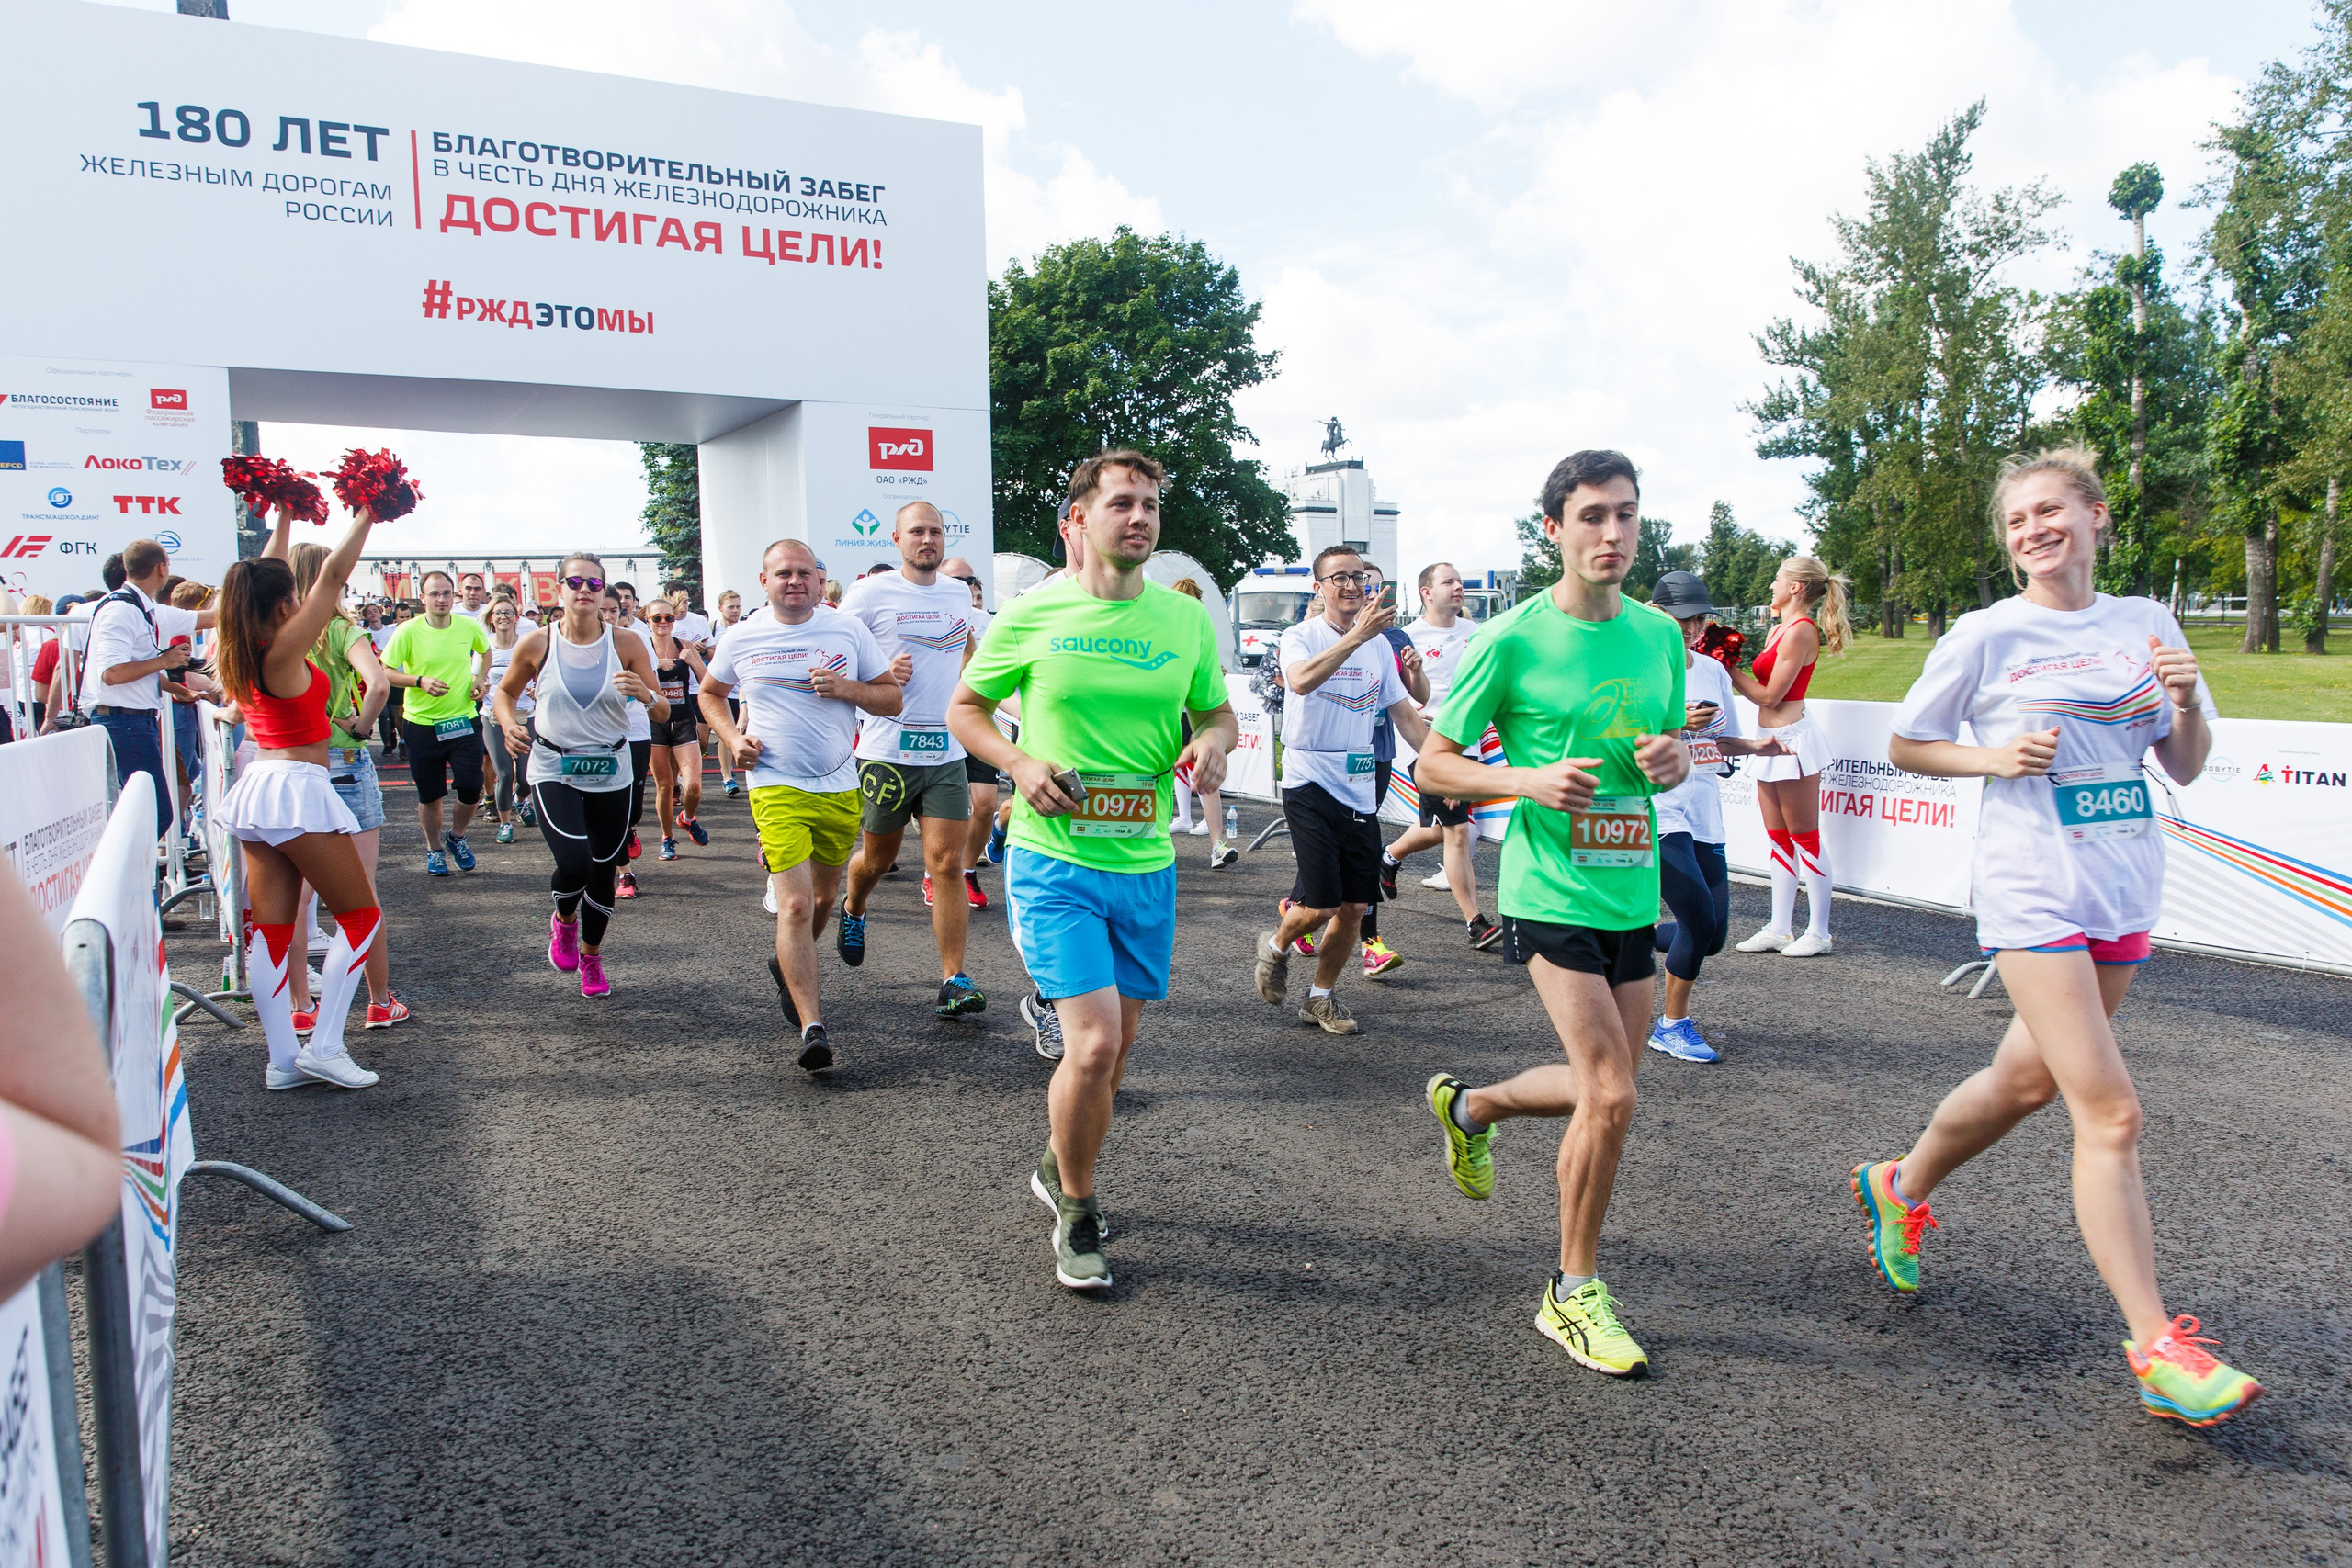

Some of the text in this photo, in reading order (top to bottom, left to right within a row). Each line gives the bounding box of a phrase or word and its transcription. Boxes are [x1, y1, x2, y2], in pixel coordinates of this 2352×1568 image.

[136, 99, 390, 162] 180 ЛЕТ
[432, 131, 886, 204] БЛАГОТВОРИТЕЛЬНЫЙ ЗАБЕГ
[79, 153, 392, 202] ЖЕЛЕЗНЫМ ДОРОГАМ
[433, 158, 888, 227] В ЧЕСТЬ ДНЯ ЖЕЛЕЗНОДОРОЖНИКА
[285, 200, 394, 228] РОССИИ
[439, 193, 884, 270] ДОСТИГАЯ ЦЕЛИ!
[11, 394, 119, 407] БЛАГОСОСТОЯНИЕ
[145, 408, 194, 416] Федеральная
[876, 475, 895, 484] ОАО
[112, 495, 183, 515] ТТК
[944, 525, 970, 534] YTIE
[59, 541, 98, 555] ФГК
[834, 539, 865, 547] ЛИНИЯ
[1049, 636, 1152, 660] saucony
[751, 654, 787, 665] ДОСТИГАЯ
[2008, 663, 2067, 683] ДОСТИГАЯ
[662, 688, 684, 697] 0488
[439, 718, 466, 732] 7081
[1239, 712, 1260, 722] ЗАБЕГ
[909, 734, 944, 749] 7843
[1237, 733, 1261, 750] ЕЛИ!
[1689, 746, 1723, 762] 0205
[571, 760, 610, 773] 7072
[2202, 764, 2241, 773] SOBYTIE
[2281, 765, 2346, 787] TITAN
[1827, 773, 1957, 798] ЖЕЛЕЗНОДОРОЖНИКА
[1082, 793, 1153, 818] 10973
[1821, 789, 1955, 829] ИГАЯ ЦЕЛИ!
[2075, 785, 2145, 818] 8460
[1577, 818, 1650, 845] 10972
